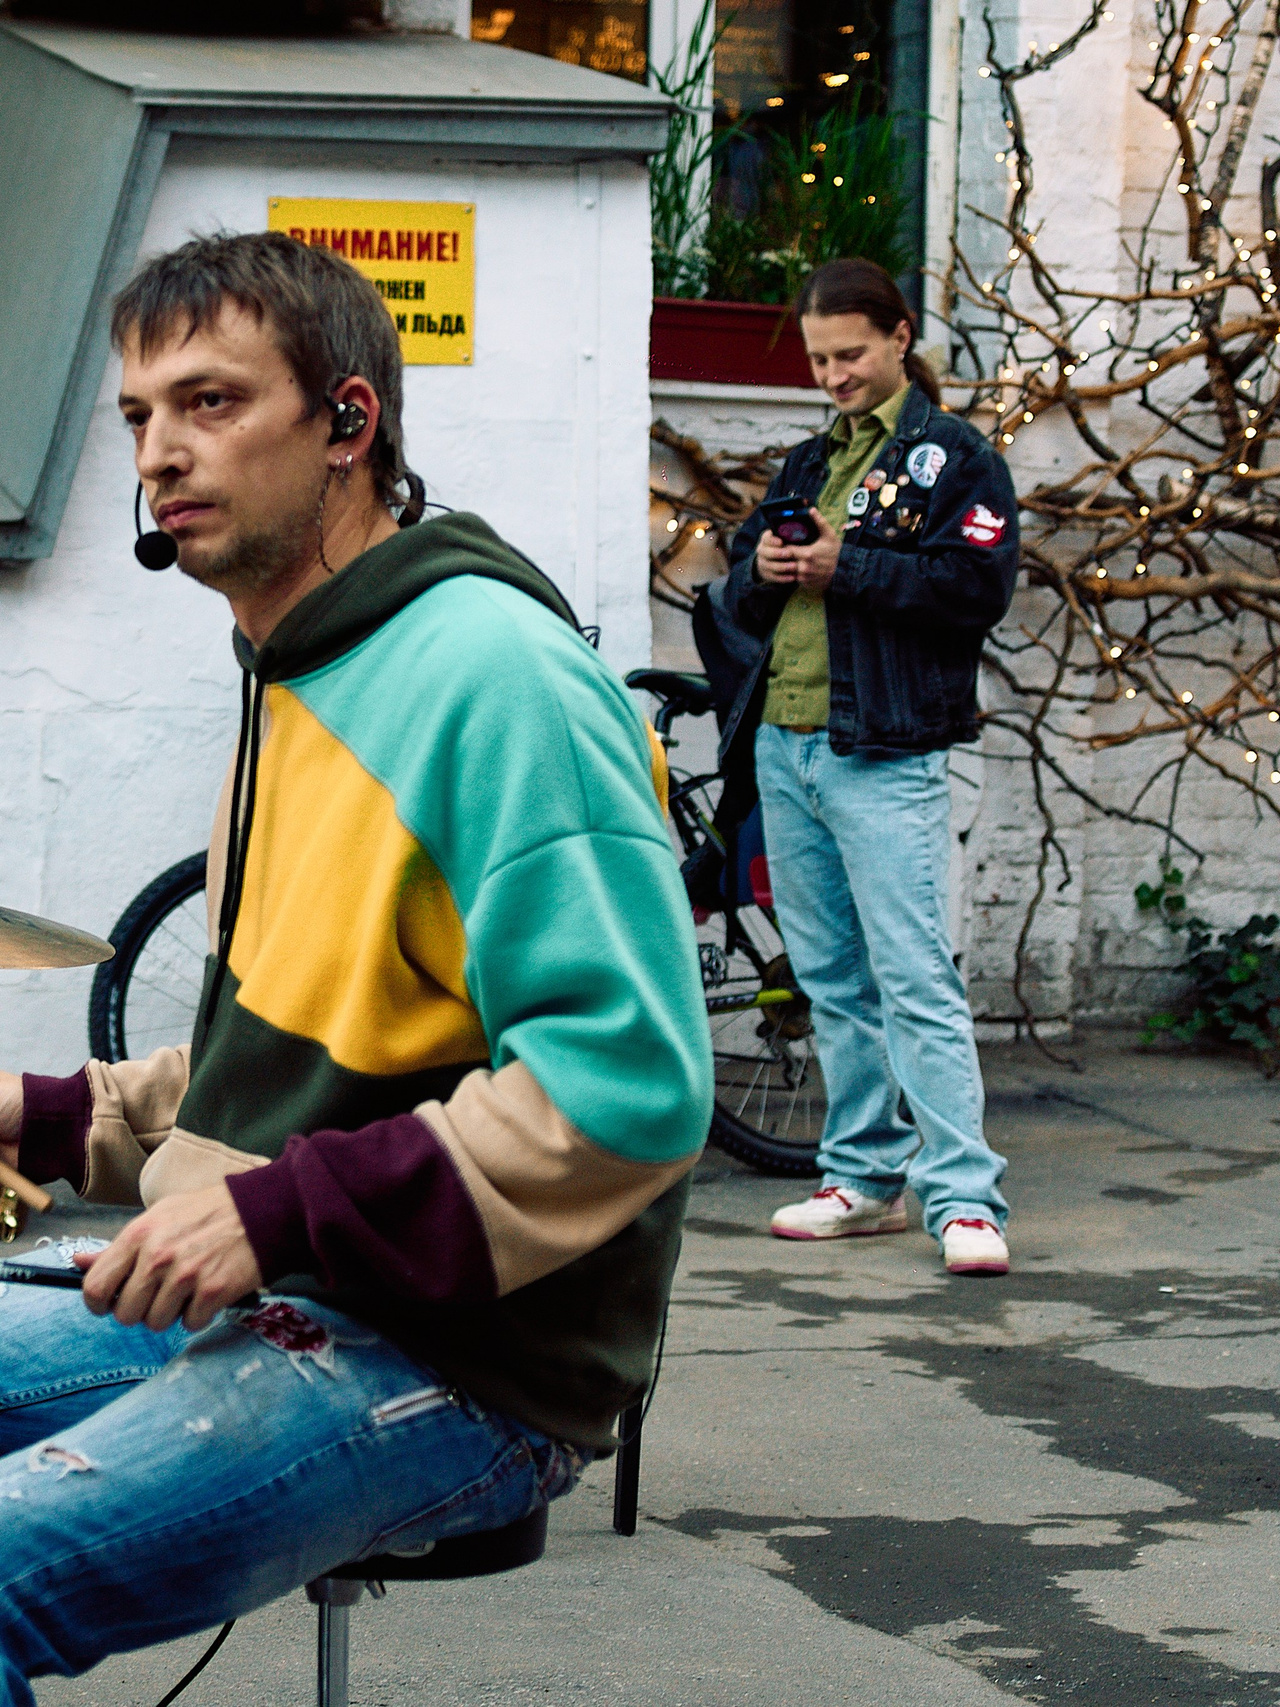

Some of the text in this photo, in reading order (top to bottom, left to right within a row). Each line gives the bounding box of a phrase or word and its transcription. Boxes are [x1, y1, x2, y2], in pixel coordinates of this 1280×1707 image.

[370, 279, 426, 301] ОЖЕН
[395, 312, 466, 337] И ЛЬДА
